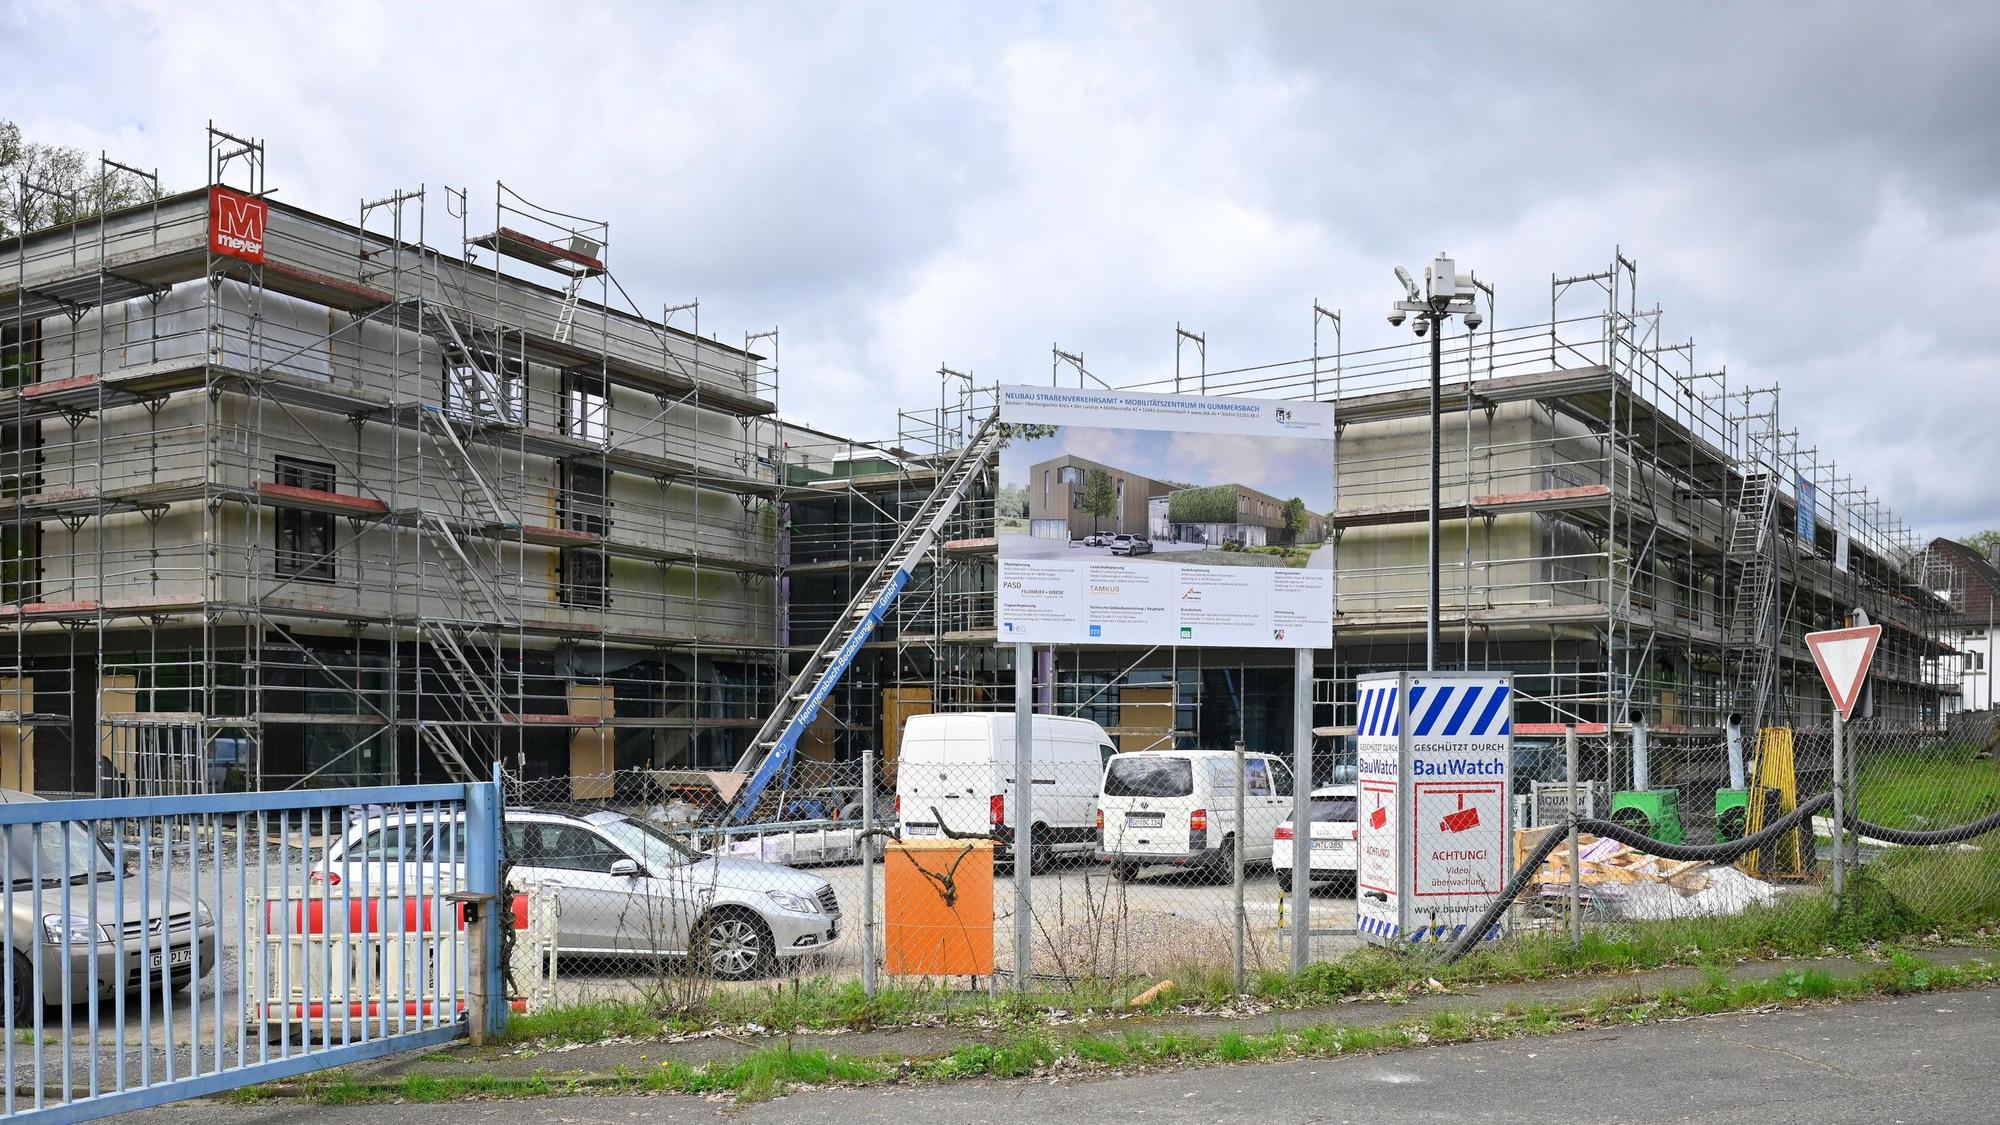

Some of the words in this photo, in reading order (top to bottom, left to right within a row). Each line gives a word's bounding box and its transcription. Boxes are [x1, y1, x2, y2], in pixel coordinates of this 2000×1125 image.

[218, 194, 263, 242] M
[217, 233, 262, 255] meyer
[1005, 392, 1035, 400] NEUBAU
[1124, 398, 1197, 409] MOBILITÄTSZENTRUM
[1208, 402, 1260, 412] GUMMERSBACH
[1003, 581, 1022, 589] PASD
[1413, 741, 1469, 752] GESCHÜTZT
[1471, 743, 1504, 752] DURCH
[1359, 757, 1398, 776] BauWatch
[1413, 757, 1504, 776] BauWatch
[1431, 849, 1488, 861] ACHTUNG!
[1431, 877, 1486, 888] überwachung
